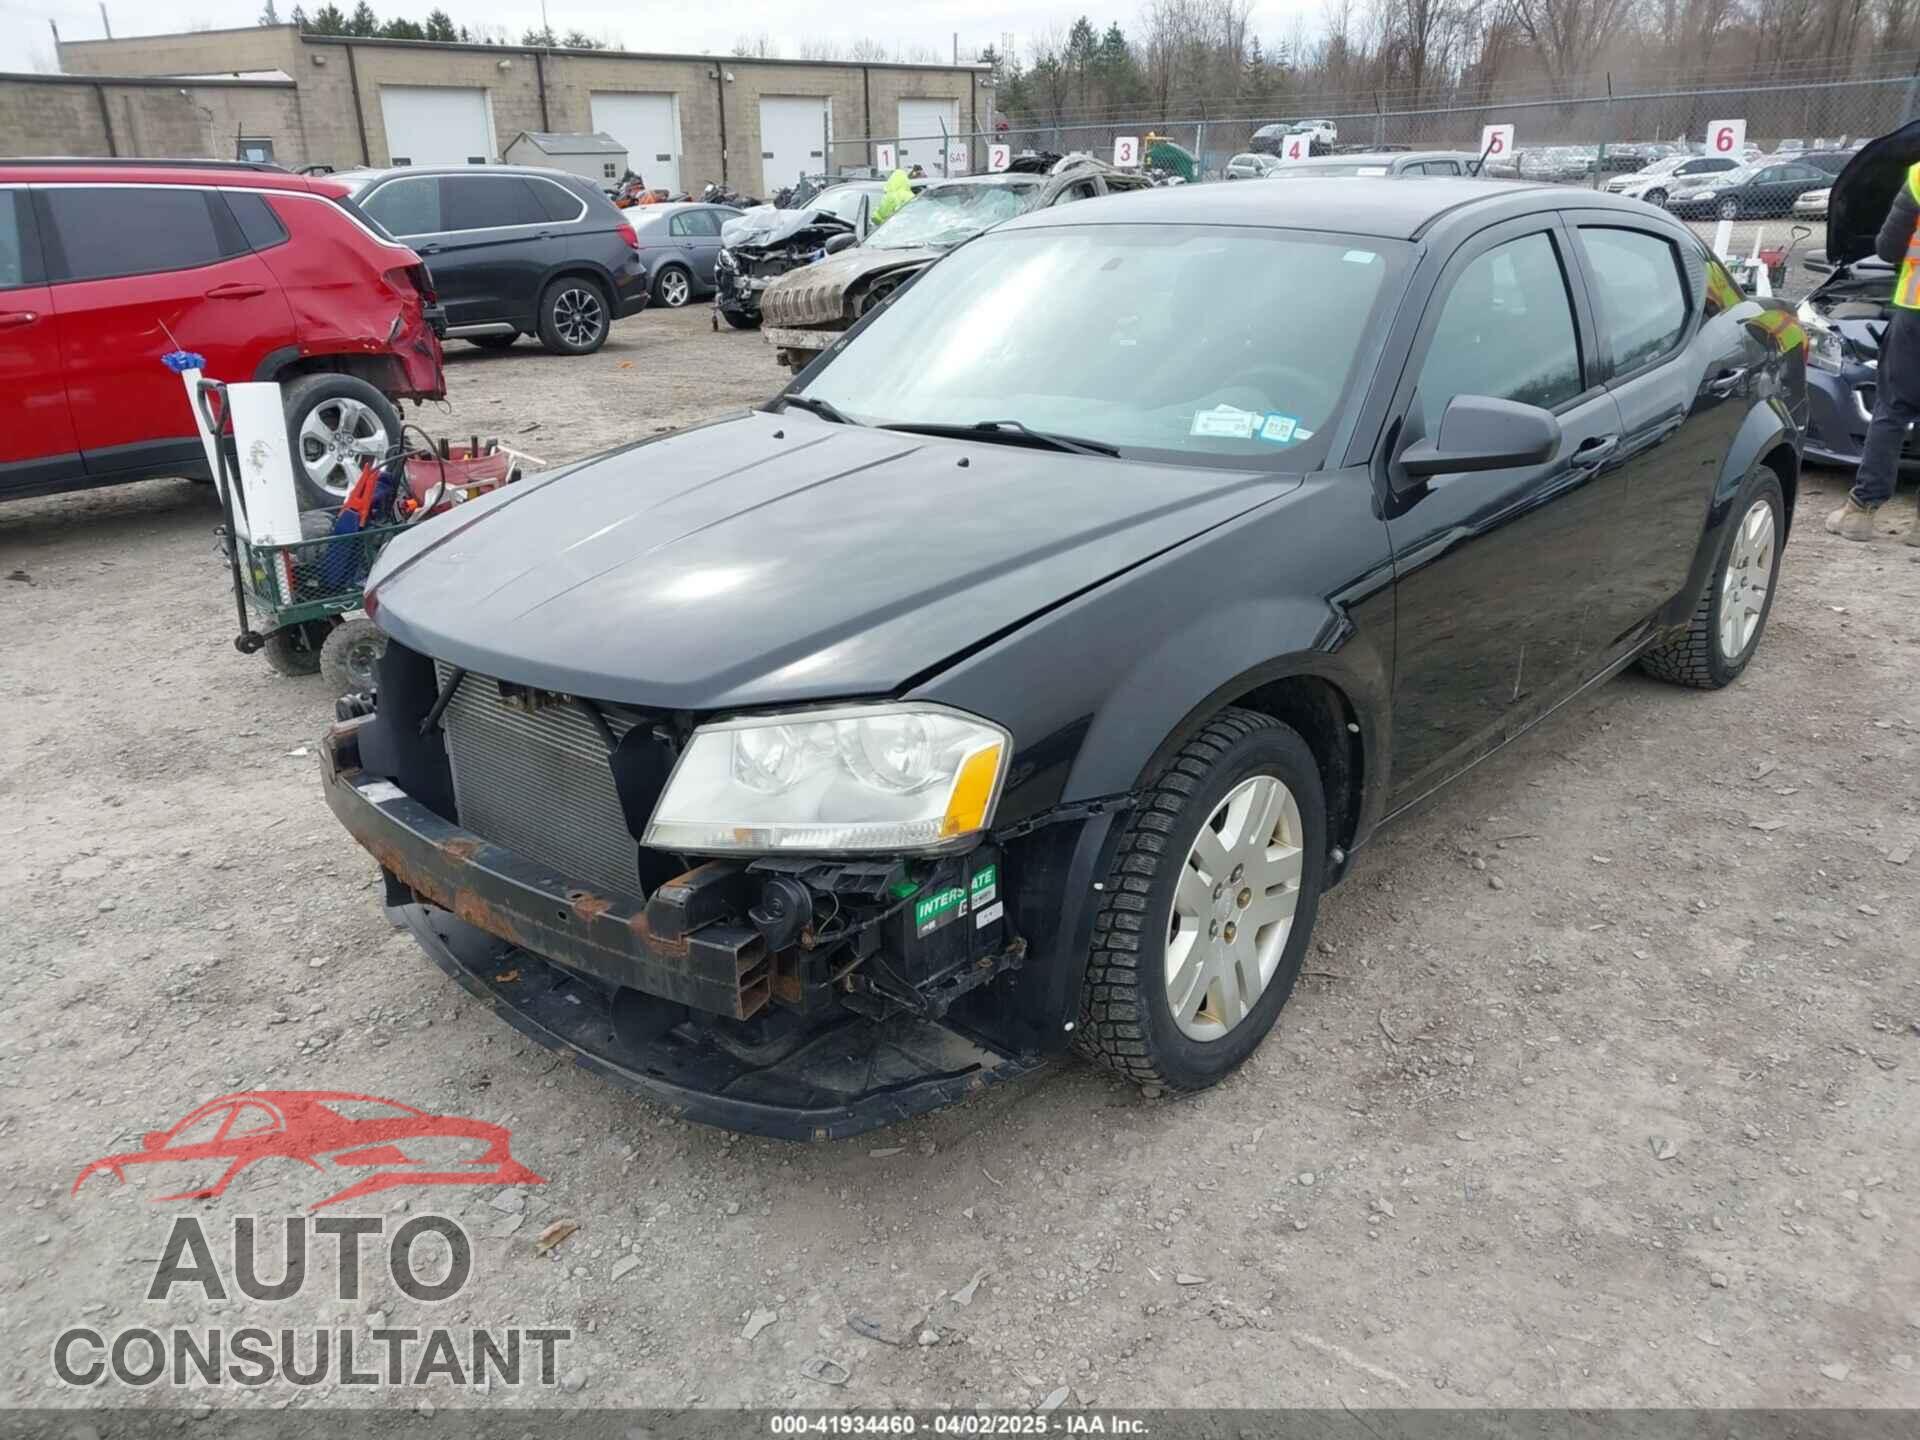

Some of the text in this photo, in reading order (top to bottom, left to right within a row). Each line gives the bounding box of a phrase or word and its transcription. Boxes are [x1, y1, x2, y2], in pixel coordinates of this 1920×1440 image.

[1491, 132, 1504, 153] 5
[1716, 127, 1734, 151] 6
[882, 150, 889, 167] 1
[1120, 143, 1131, 161] 3
[1289, 140, 1301, 159] 4
[994, 150, 1004, 168] 2
